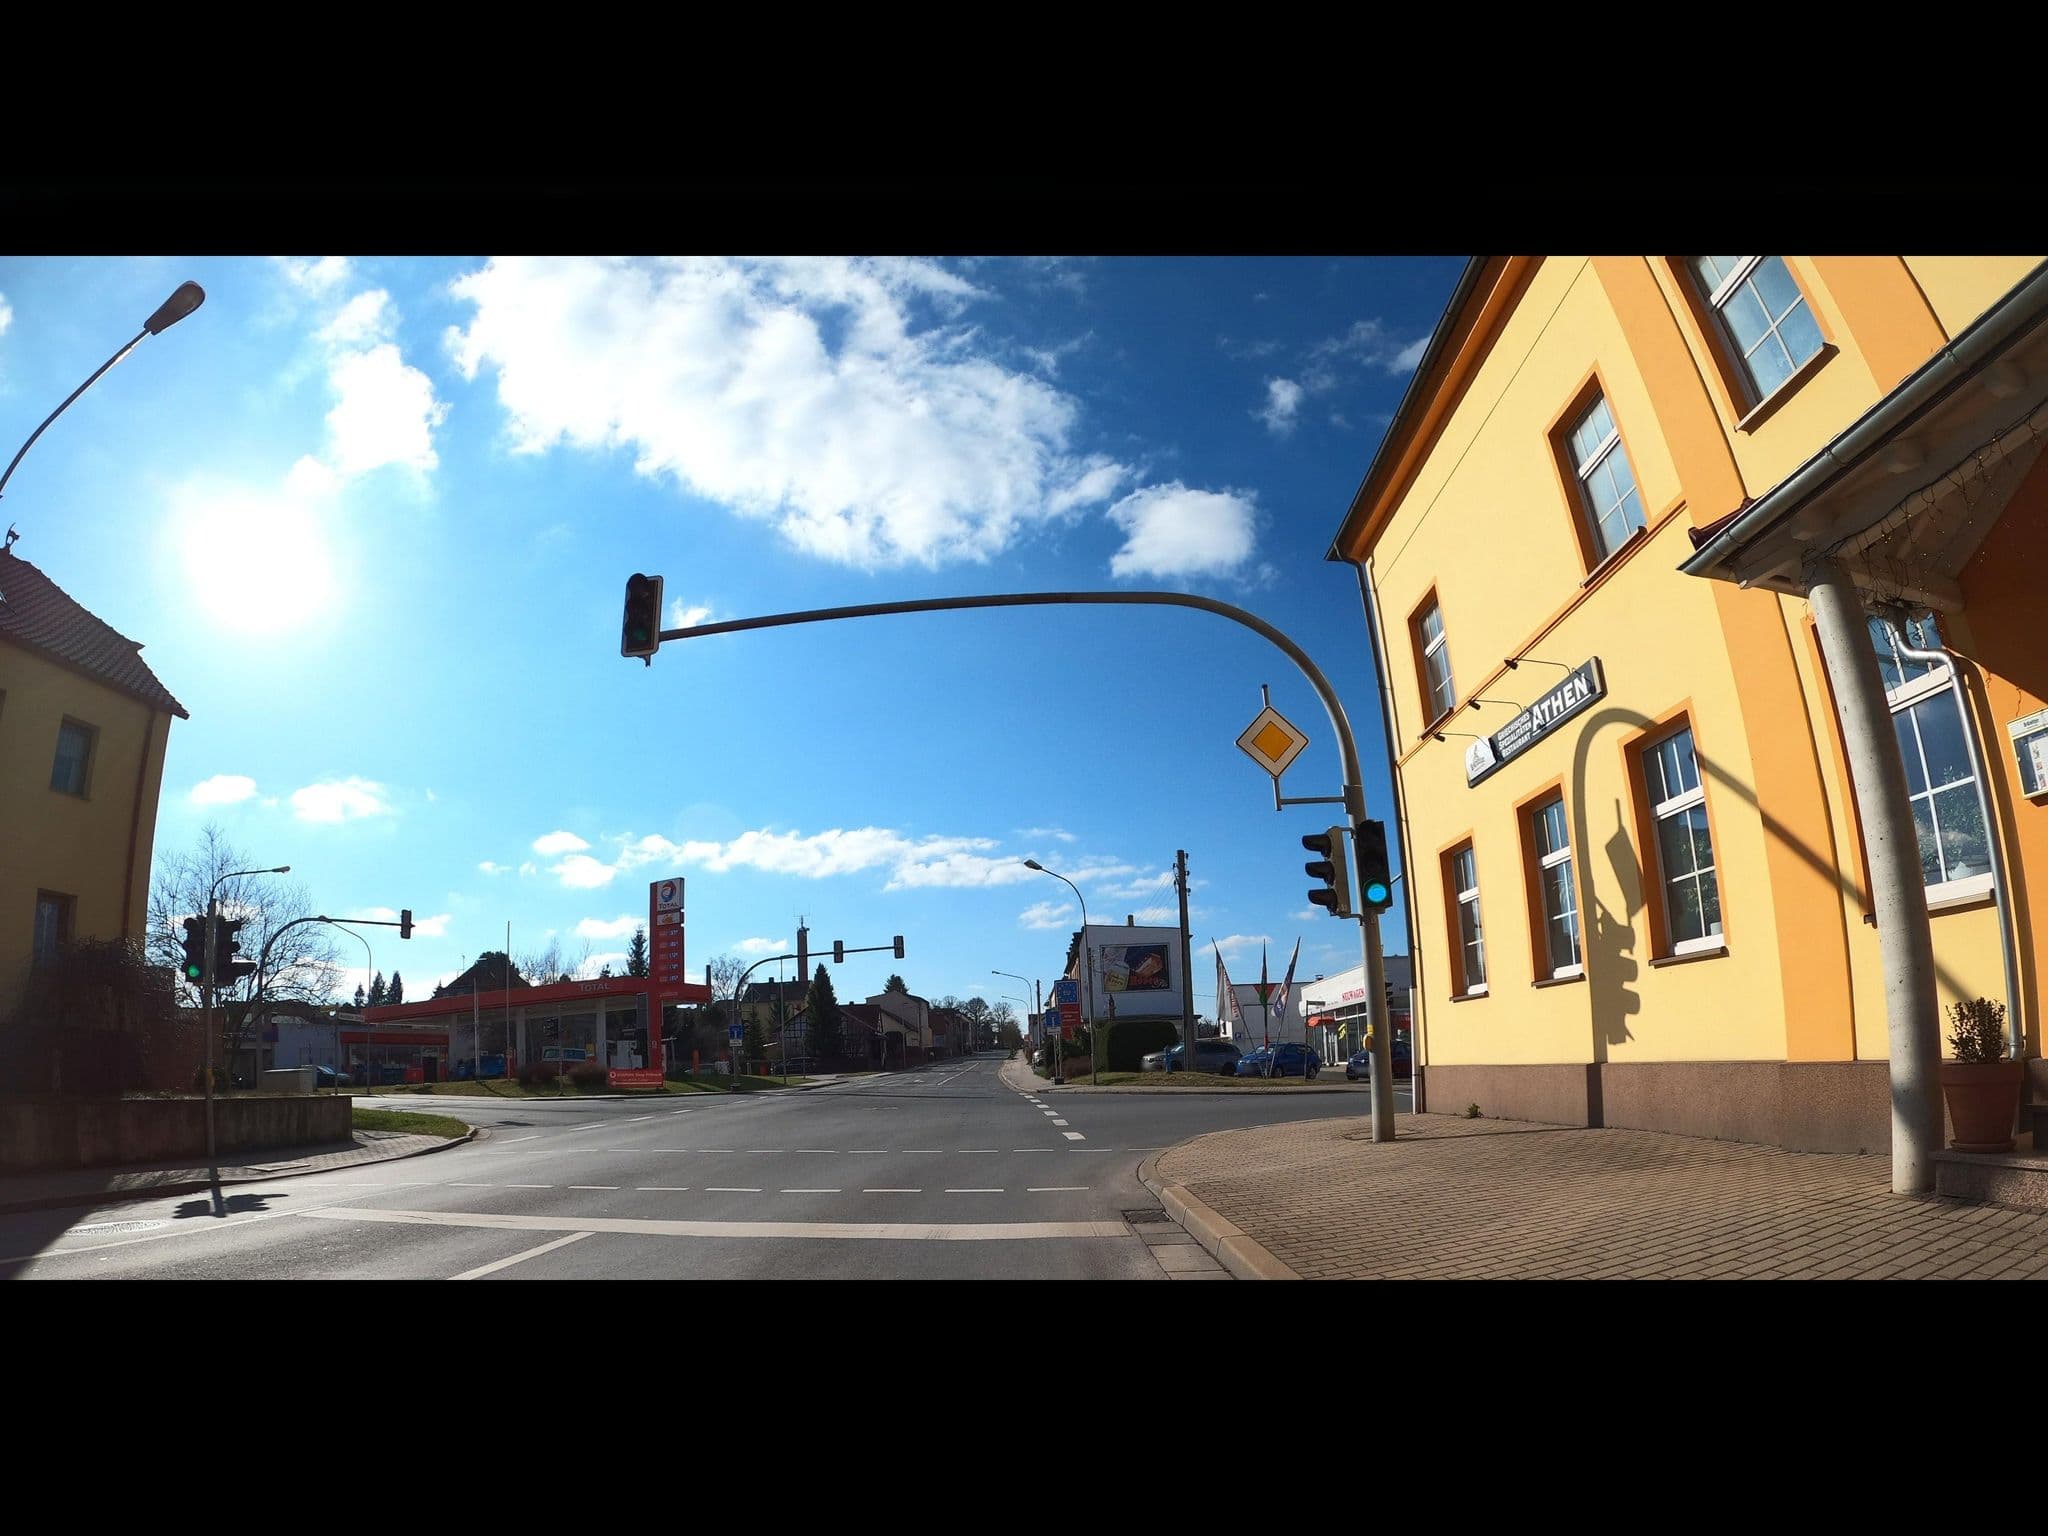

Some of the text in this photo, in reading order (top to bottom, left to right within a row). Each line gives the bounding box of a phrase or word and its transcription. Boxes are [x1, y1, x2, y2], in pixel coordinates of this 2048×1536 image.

[1532, 673, 1589, 732] ATHEN
[658, 902, 679, 910] TOTAL
[580, 982, 611, 992] TOTAL
